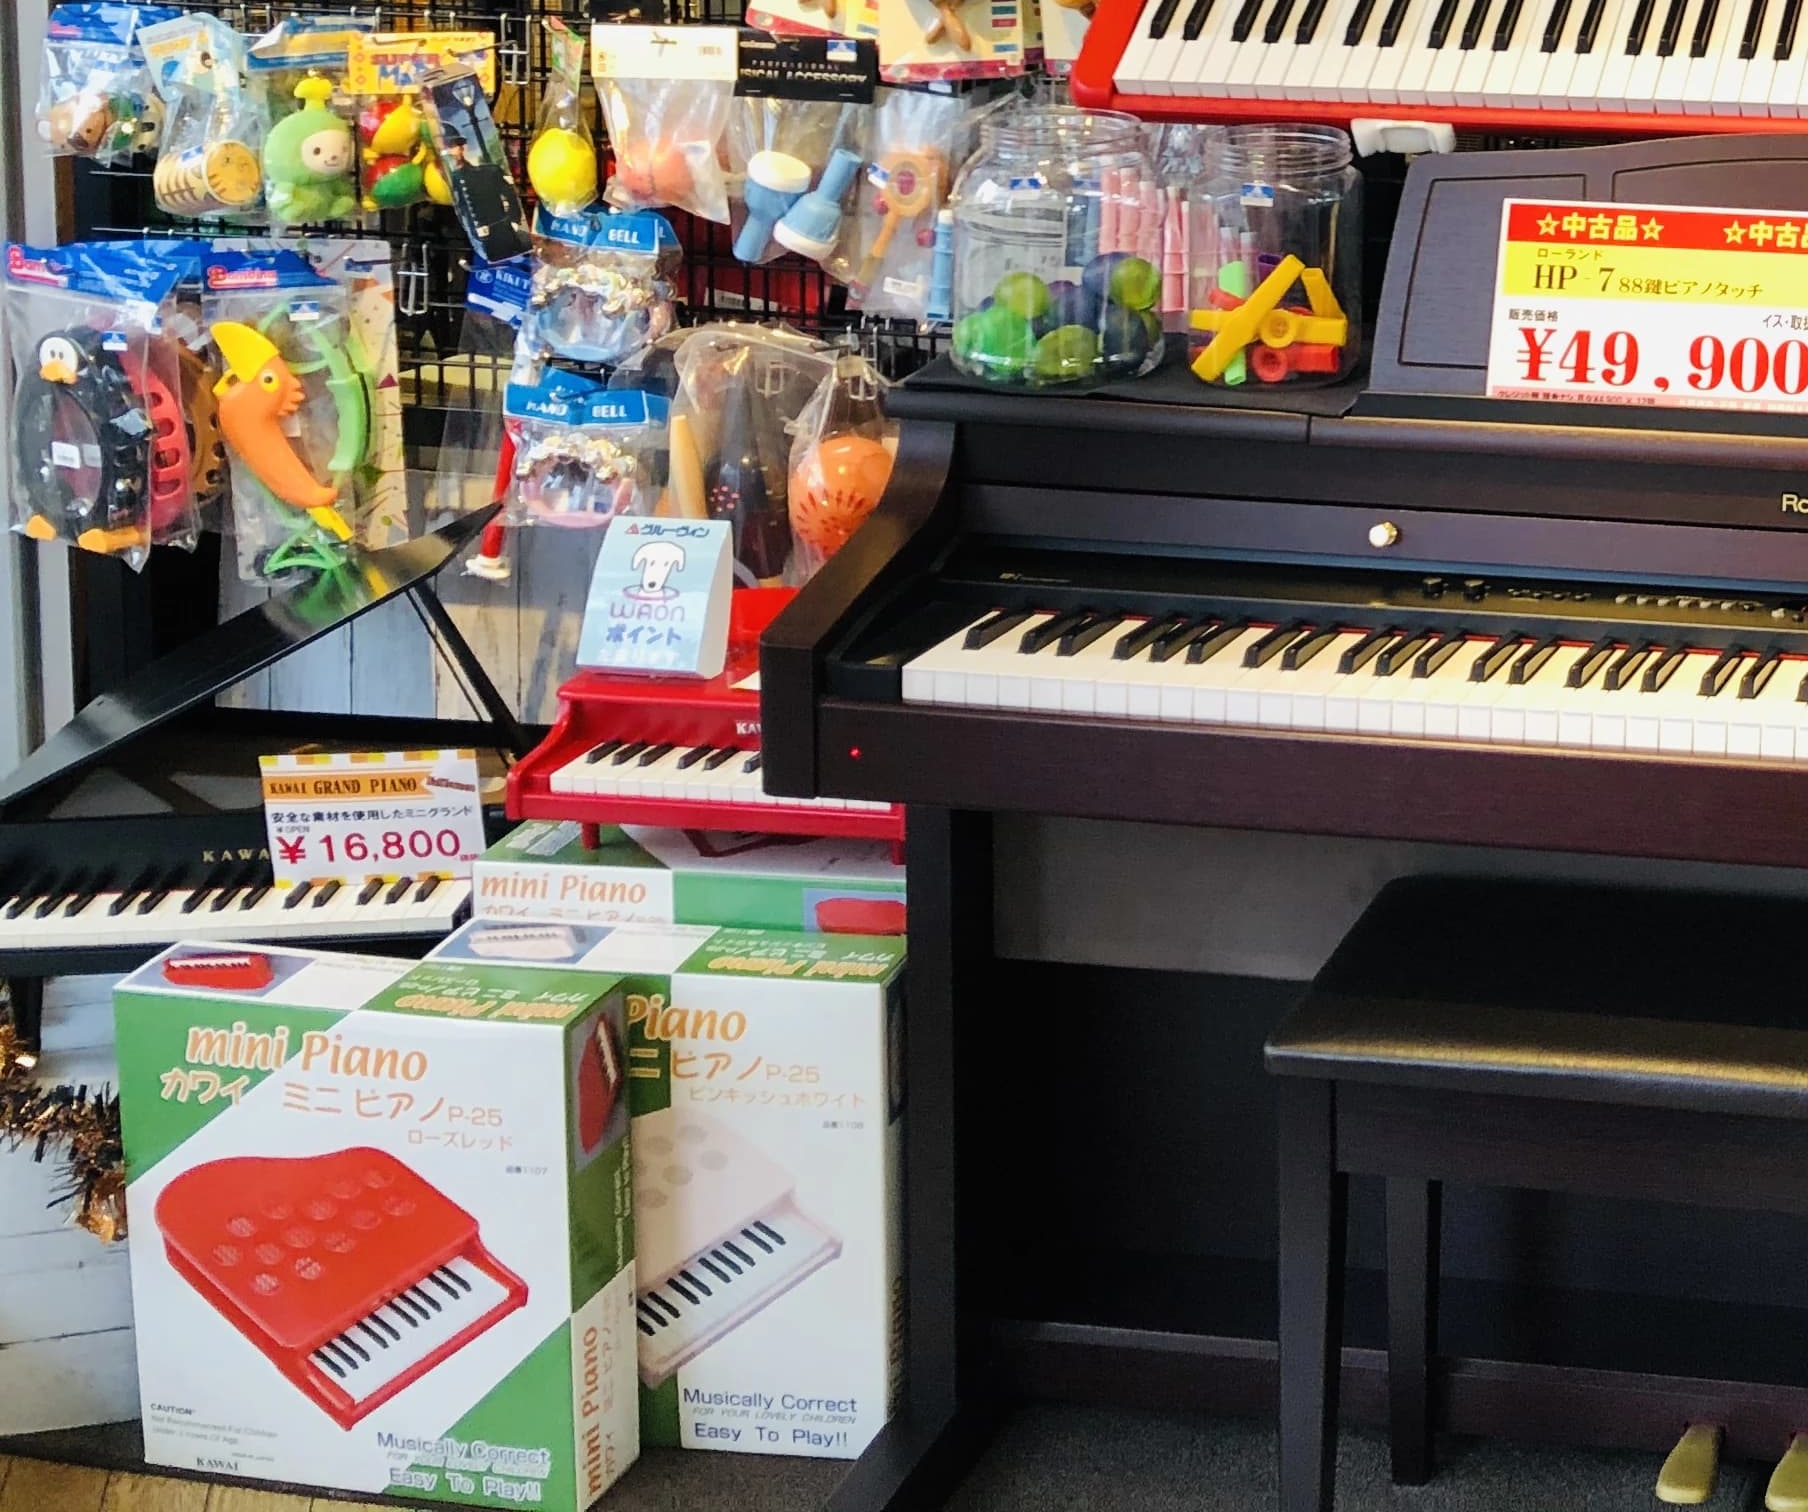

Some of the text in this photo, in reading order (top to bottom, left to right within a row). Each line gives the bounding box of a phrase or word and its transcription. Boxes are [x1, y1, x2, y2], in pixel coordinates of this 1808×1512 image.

[608, 228, 640, 244] BELL
[1562, 212, 1637, 241] 中古品
[1537, 248, 1604, 262] ローランド
[1508, 308, 1559, 323] 販売価格
[606, 623, 683, 646] ポイント
[313, 779, 361, 795] GRAND
[370, 777, 417, 793] PIANO
[276, 828, 461, 865] ¥16,800
[480, 872, 647, 905] mini Piano
[186, 1021, 429, 1082] mini Piano
[672, 1050, 820, 1084] ピアノ P-25
[160, 1068, 504, 1128] カワイ ミニ ピアノ P-25
[407, 1130, 513, 1153] ローズレッド
[683, 1388, 858, 1414] Musically Correct
[376, 1430, 469, 1460] Musically
[470, 1439, 551, 1466] Correct
[694, 1422, 848, 1448] Easy To Play!!
[196, 1456, 241, 1471] KAWAI
[388, 1467, 542, 1502] Easy To Play!!
